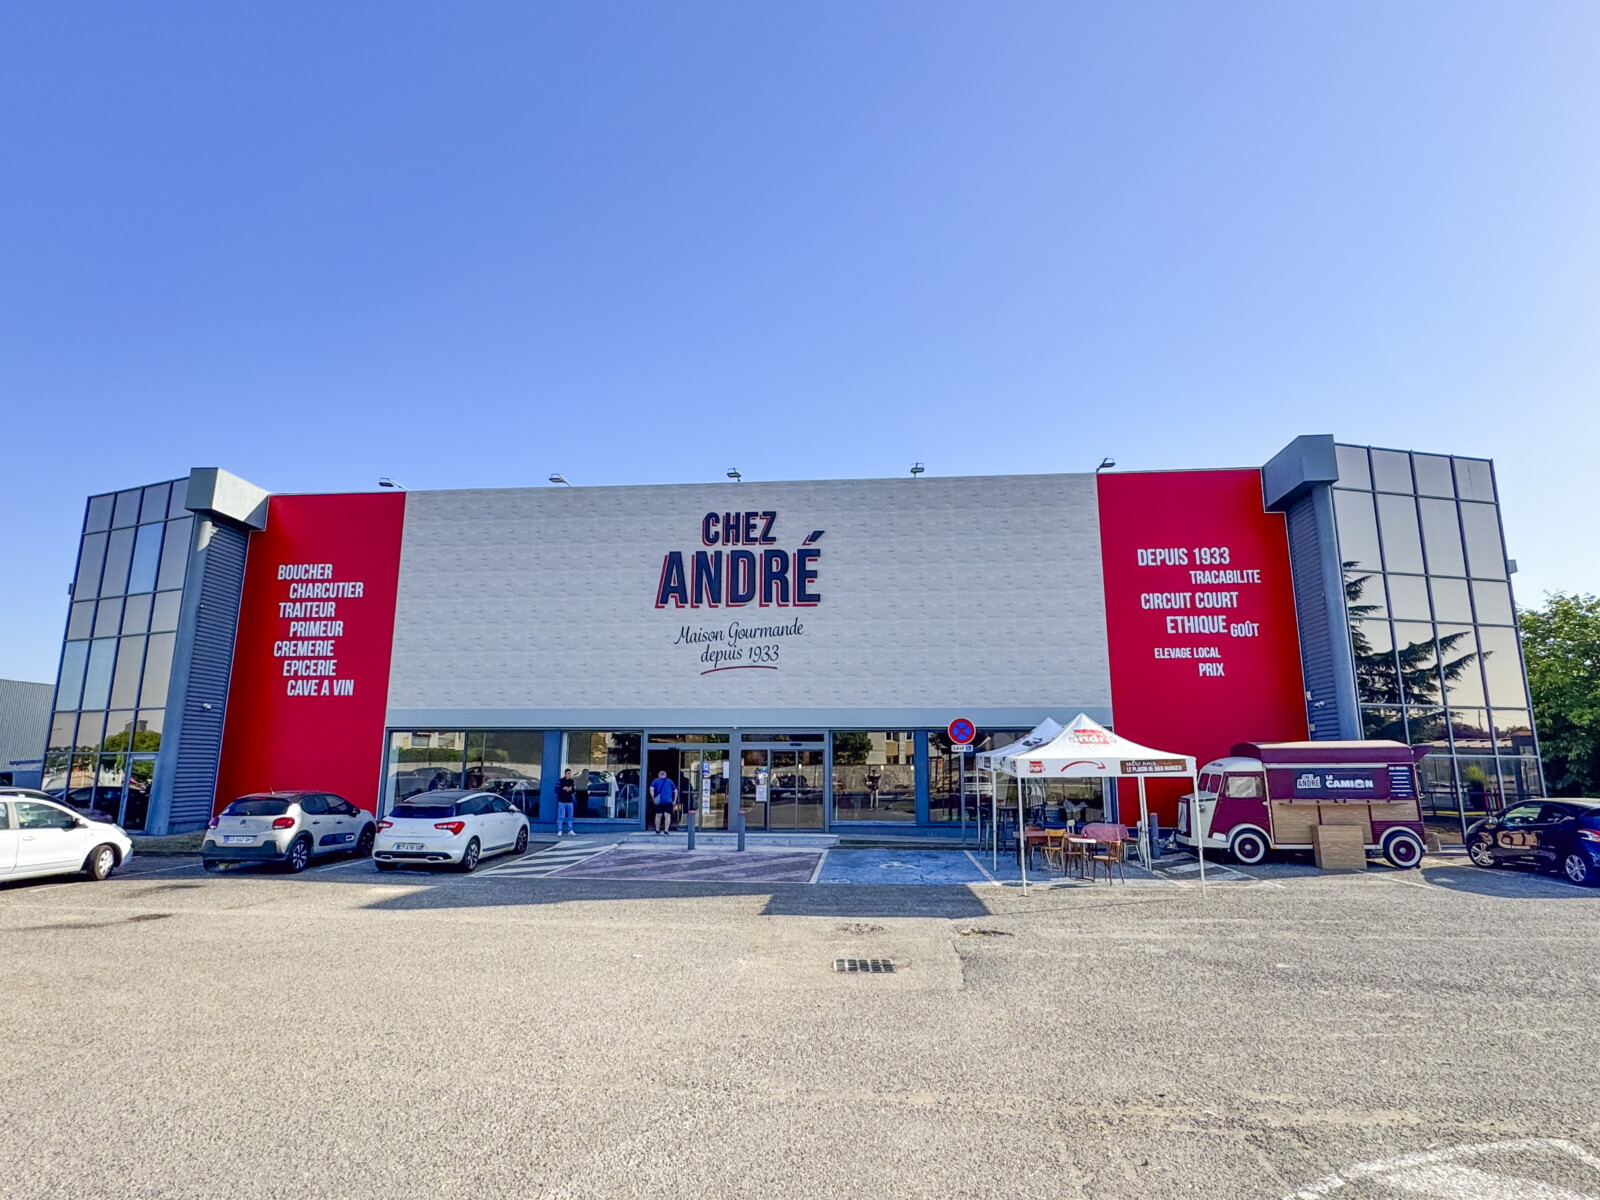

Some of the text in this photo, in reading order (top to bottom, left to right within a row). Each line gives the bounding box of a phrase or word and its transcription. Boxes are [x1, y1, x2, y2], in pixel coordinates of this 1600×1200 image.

[702, 511, 776, 546] CHEZ
[1137, 547, 1230, 566] DEPUIS 1933
[277, 564, 333, 580] BOUCHER
[655, 530, 825, 609] ANDRÉ
[1189, 570, 1261, 584] TRACABILITE
[289, 582, 364, 598] CHARCUTIER
[1140, 592, 1238, 609] CIRCUIT COURT
[279, 602, 336, 618] TRAITEUR
[289, 621, 344, 637] PRIMEUR
[674, 617, 804, 647] Maison Gourmande
[1166, 615, 1259, 637] ETHIQUE GOÛT
[274, 640, 335, 657] CREMERIE
[701, 644, 779, 668] depuis 1933
[1154, 647, 1221, 659] ELEVAGE LOCAL
[283, 660, 337, 676] EPICERIE
[1199, 663, 1225, 676] PRIX
[287, 679, 354, 696] CAVE A VIN
